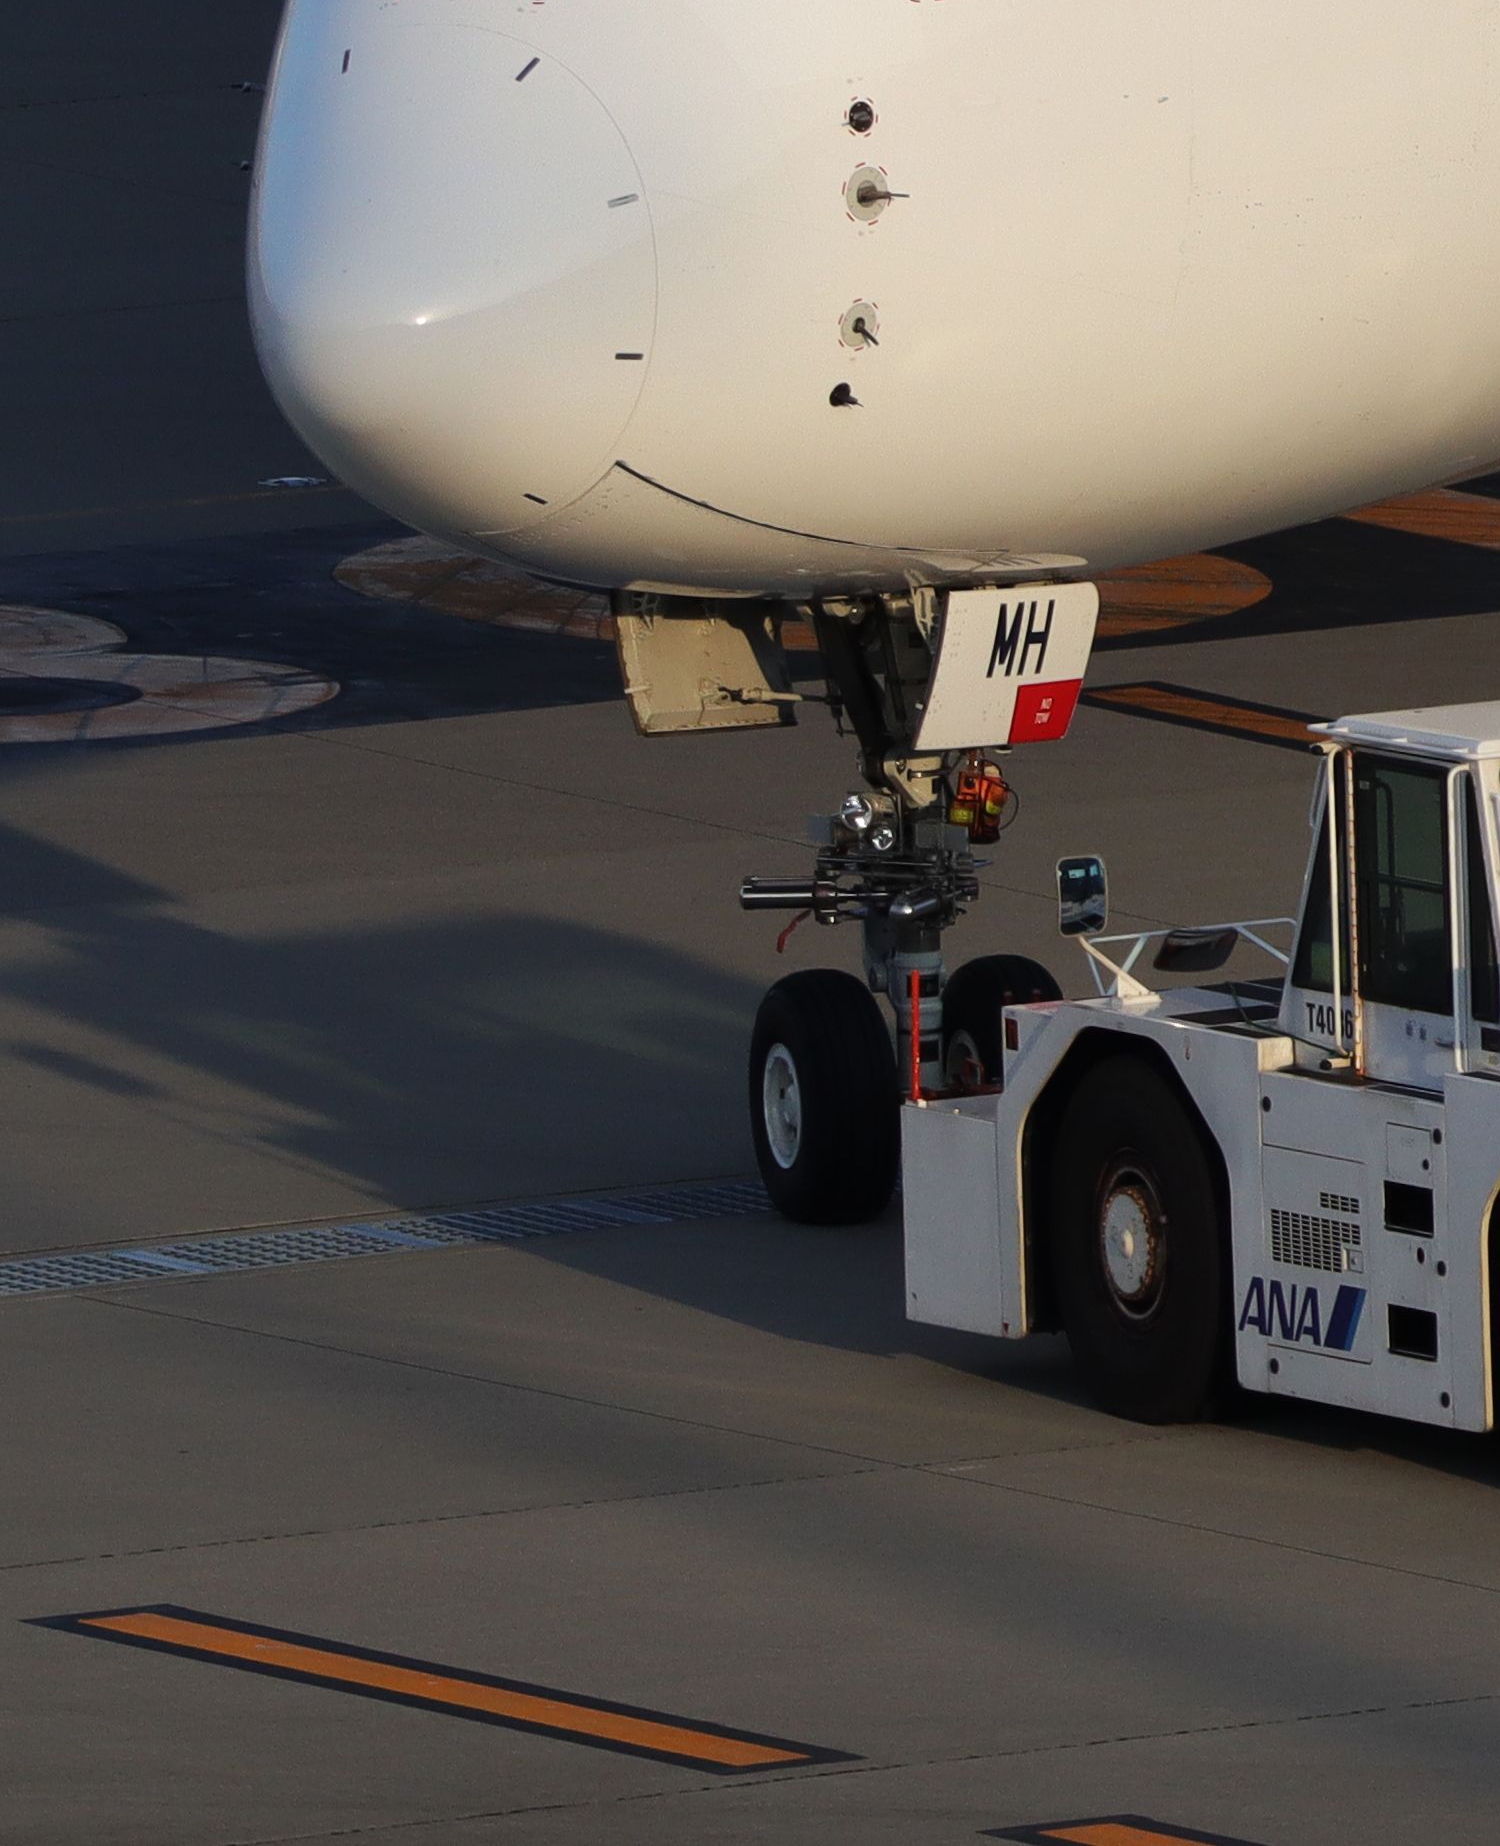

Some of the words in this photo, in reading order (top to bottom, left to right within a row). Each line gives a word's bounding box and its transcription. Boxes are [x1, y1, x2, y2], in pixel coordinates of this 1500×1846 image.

[986, 599, 1056, 678] MH
[1305, 1002, 1353, 1040] T406
[1238, 1276, 1322, 1347] ANA
